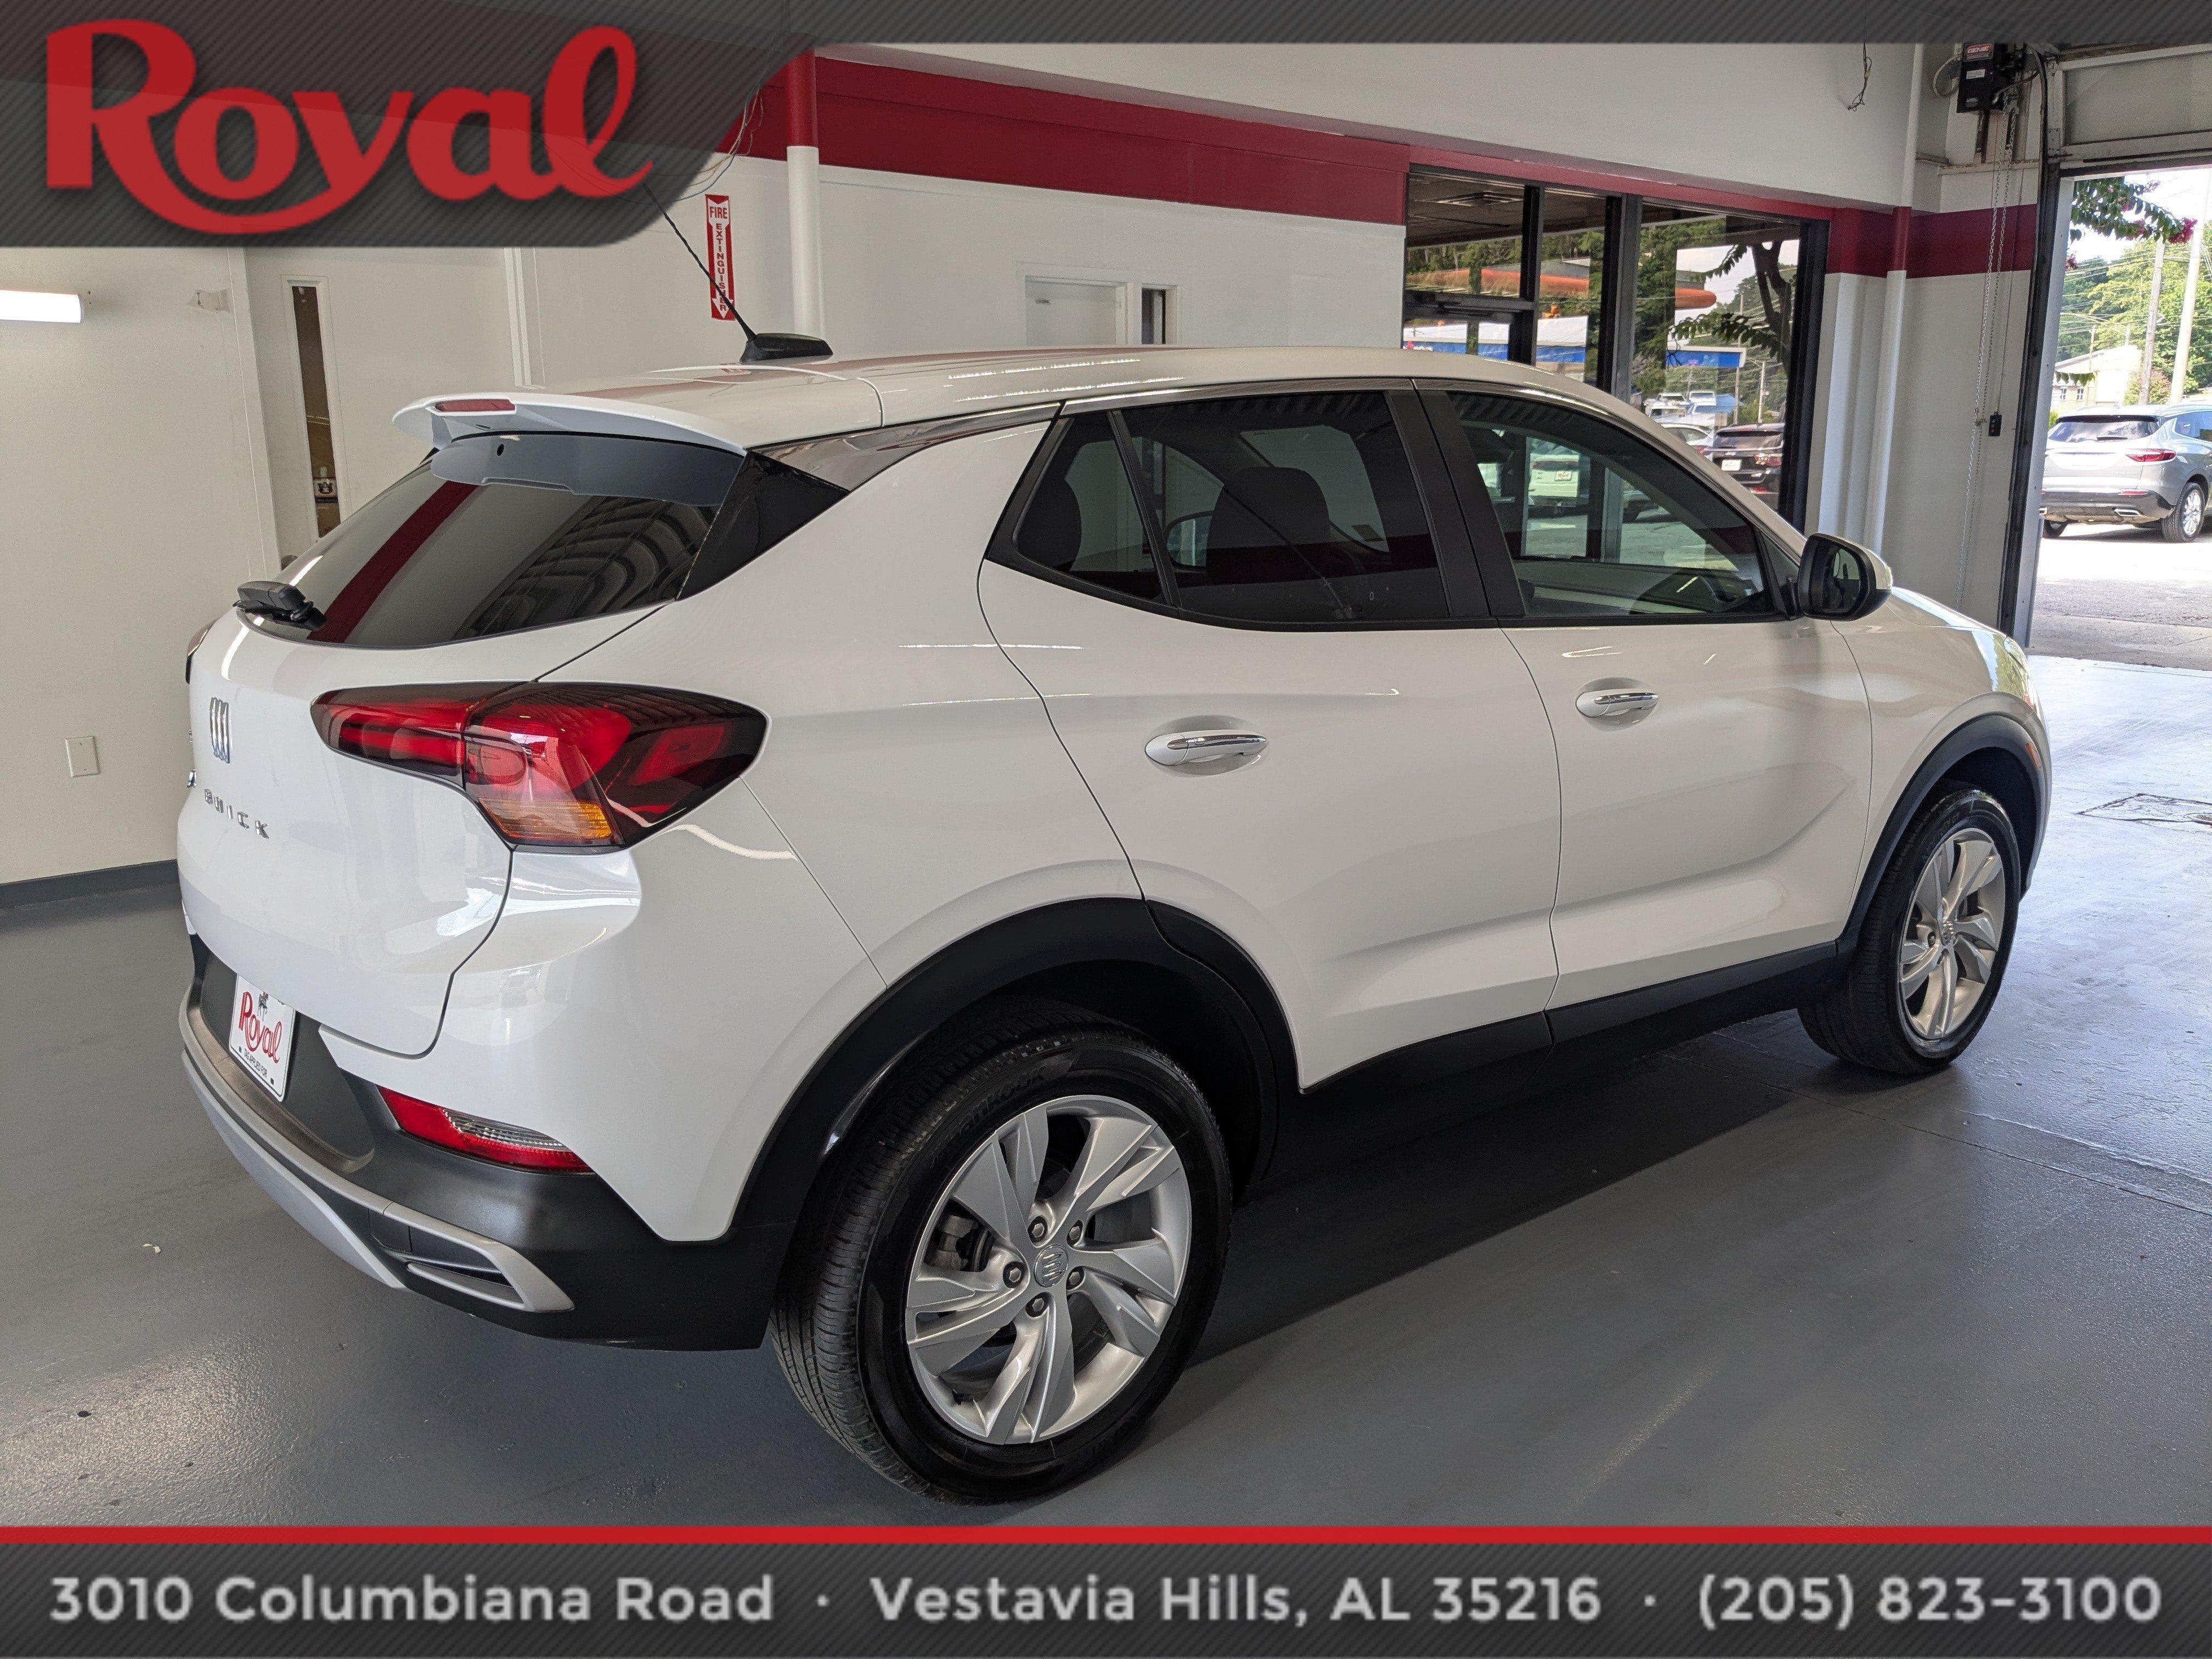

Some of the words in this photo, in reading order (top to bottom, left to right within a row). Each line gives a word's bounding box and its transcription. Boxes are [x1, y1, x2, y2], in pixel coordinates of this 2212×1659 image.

[709, 206, 728, 219] FIRE
[204, 788, 269, 839] BUICK
[238, 991, 282, 1063] Royal
